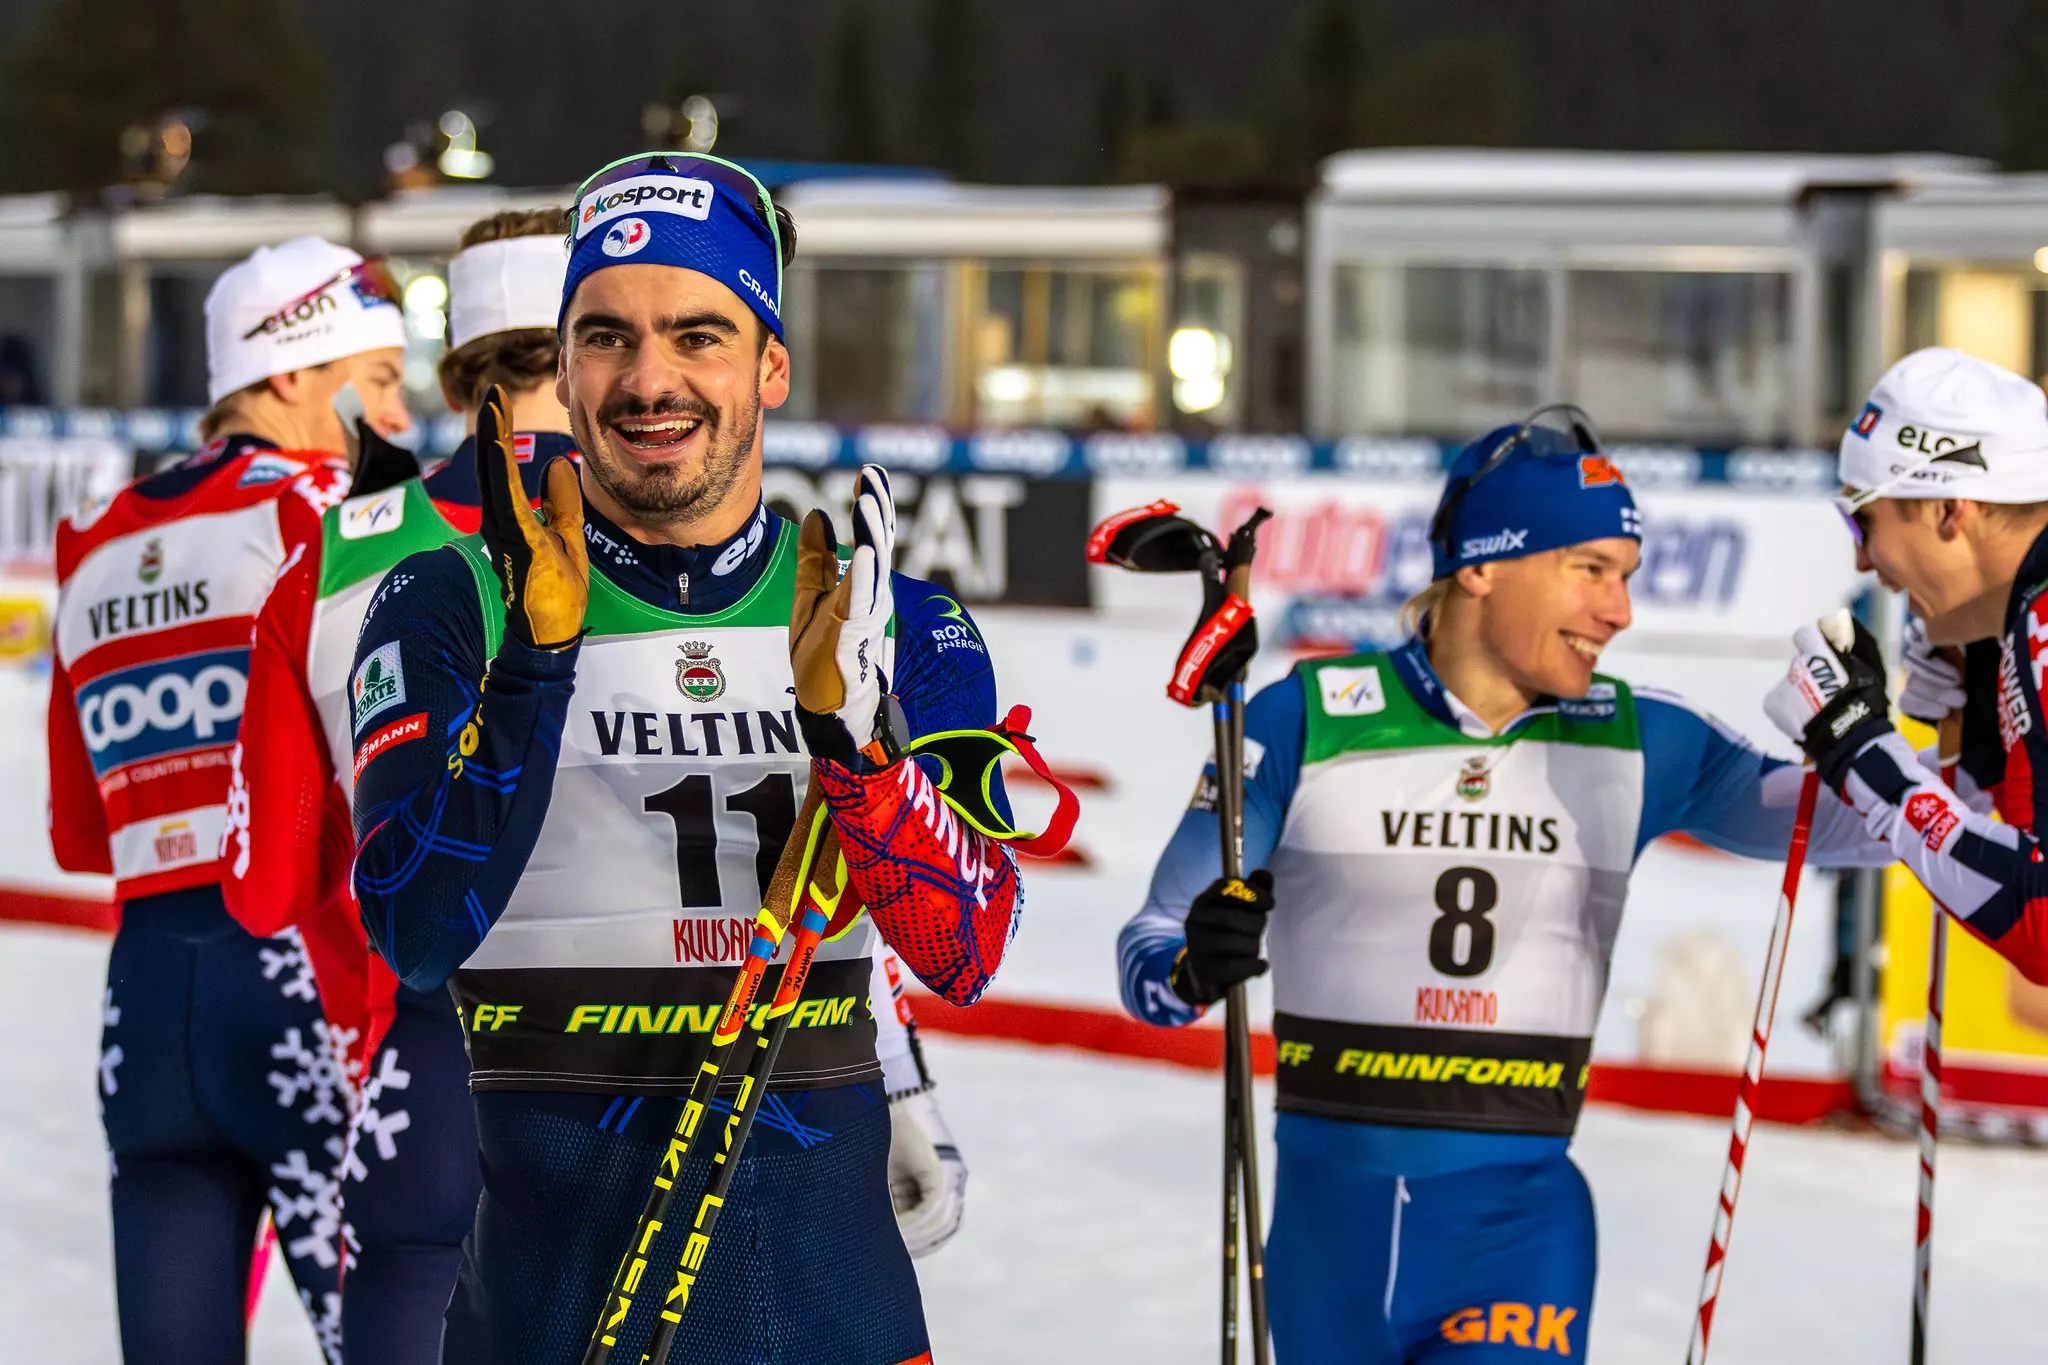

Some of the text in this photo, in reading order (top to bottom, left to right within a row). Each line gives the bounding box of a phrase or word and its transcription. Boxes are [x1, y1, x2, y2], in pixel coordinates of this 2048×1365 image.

[583, 185, 706, 224] ekosport
[88, 579, 210, 641] VELTINS
[932, 624, 969, 641] ROY
[937, 638, 985, 654] ENERGIE
[81, 664, 248, 752] coop
[590, 710, 801, 757] VELTIN
[644, 772, 797, 909] 11
[1380, 810, 1561, 854] VELTINS
[673, 917, 781, 963] KUUSA
[1428, 866, 1498, 979] 8
[473, 1005, 525, 1032] FF
[1279, 1041, 1314, 1066] FF
[661, 1194, 725, 1324] LEKI
[1440, 1302, 1578, 1357] GRK
